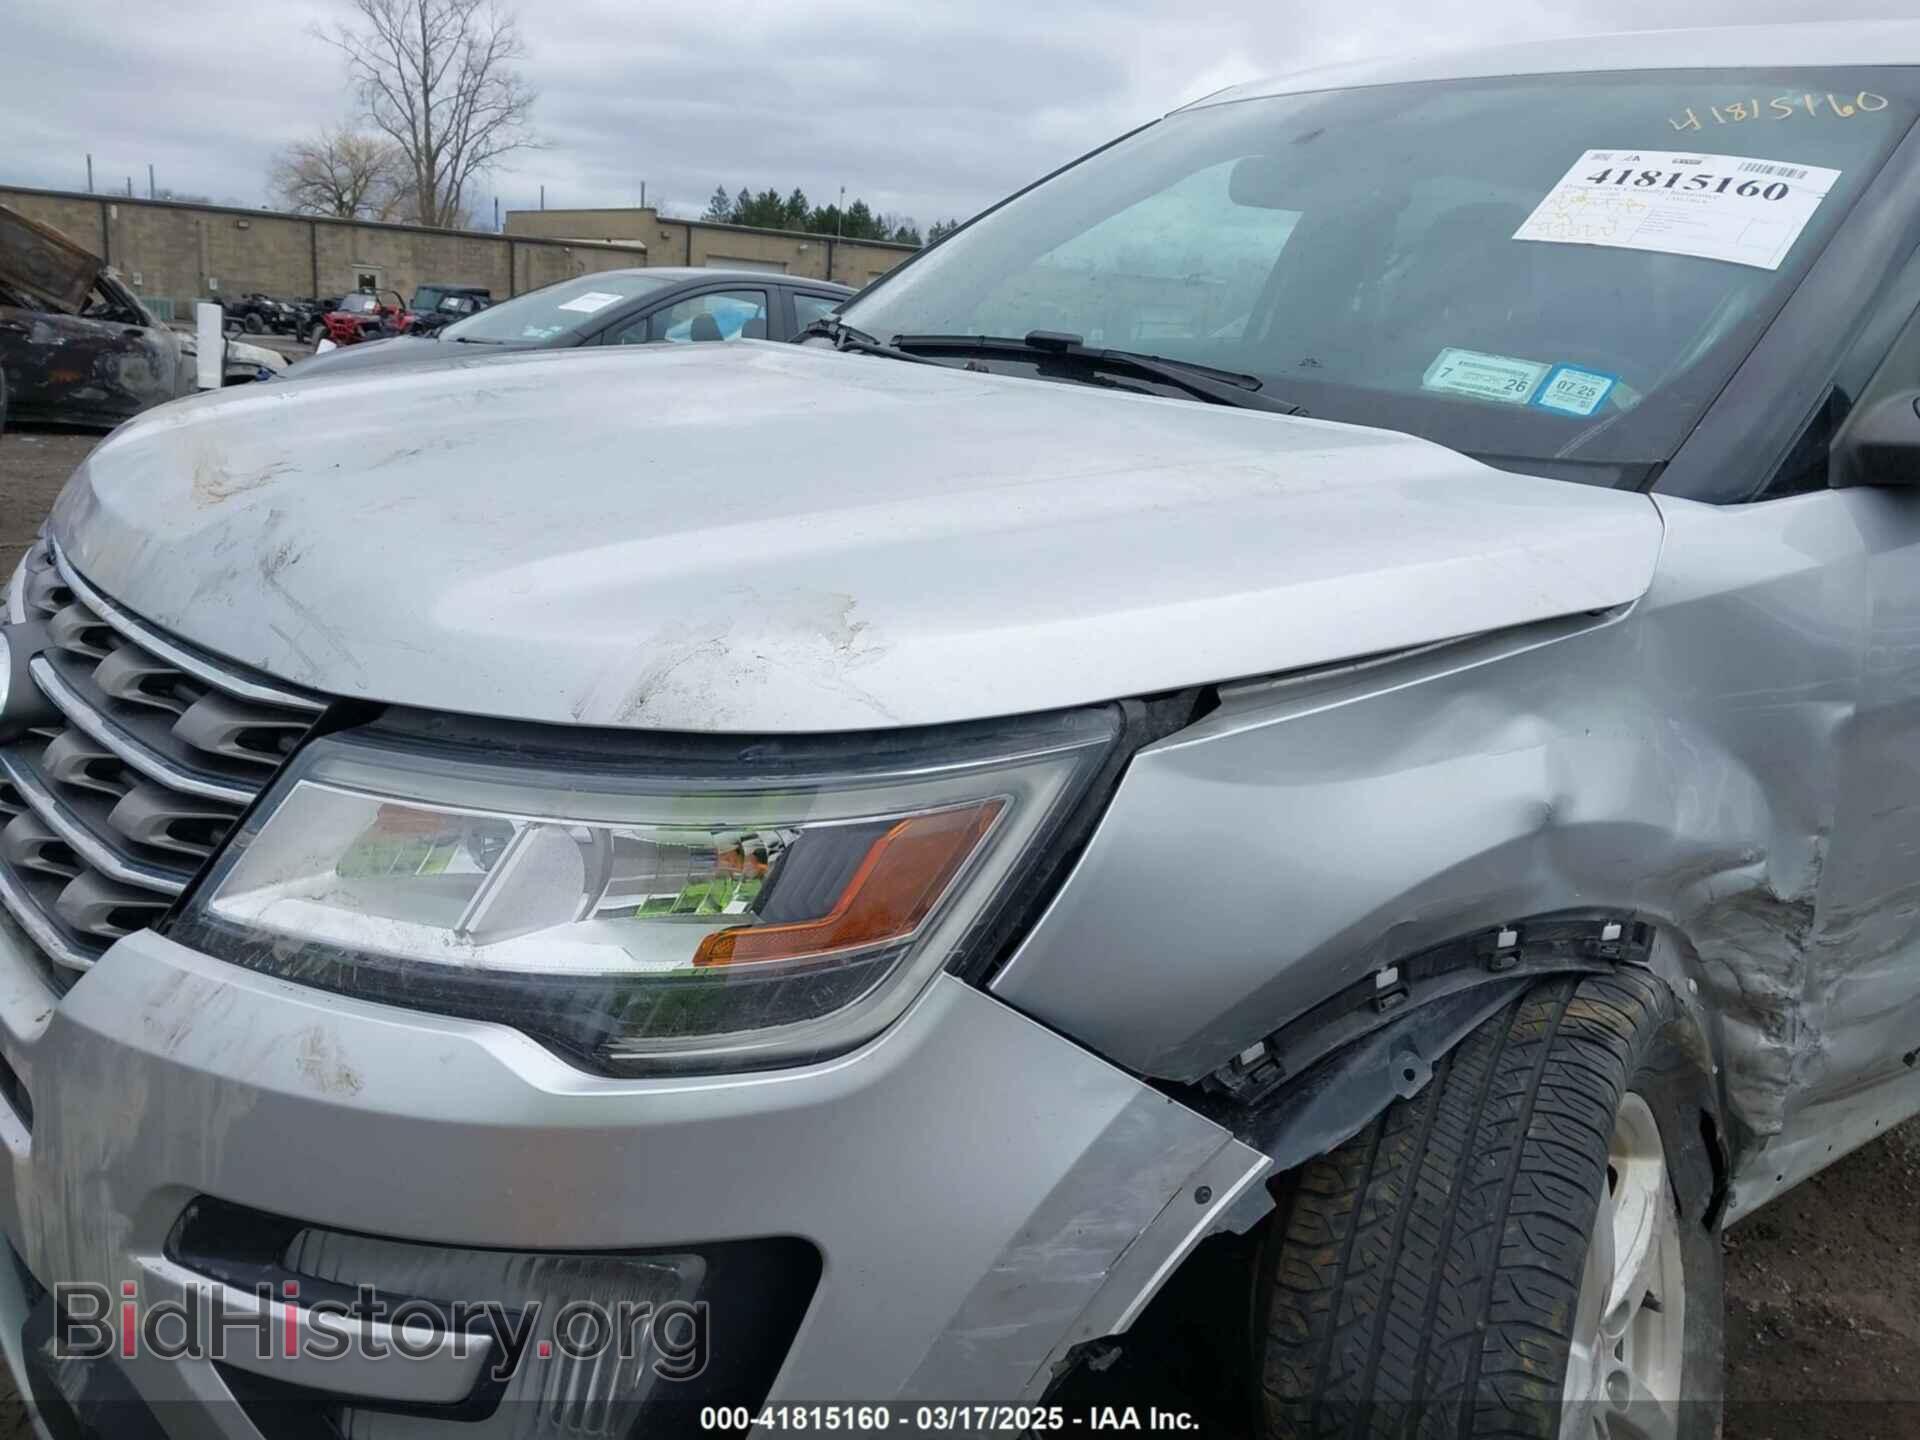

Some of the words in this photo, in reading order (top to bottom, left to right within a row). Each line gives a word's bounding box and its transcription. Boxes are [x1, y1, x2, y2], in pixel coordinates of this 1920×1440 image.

[1670, 91, 1889, 131] 41815160
[1586, 168, 1789, 201] 41815160
[1440, 367, 1453, 379] 7
[1504, 378, 1529, 393] 26
[1557, 379, 1577, 393] 07
[1578, 384, 1597, 398] 25
